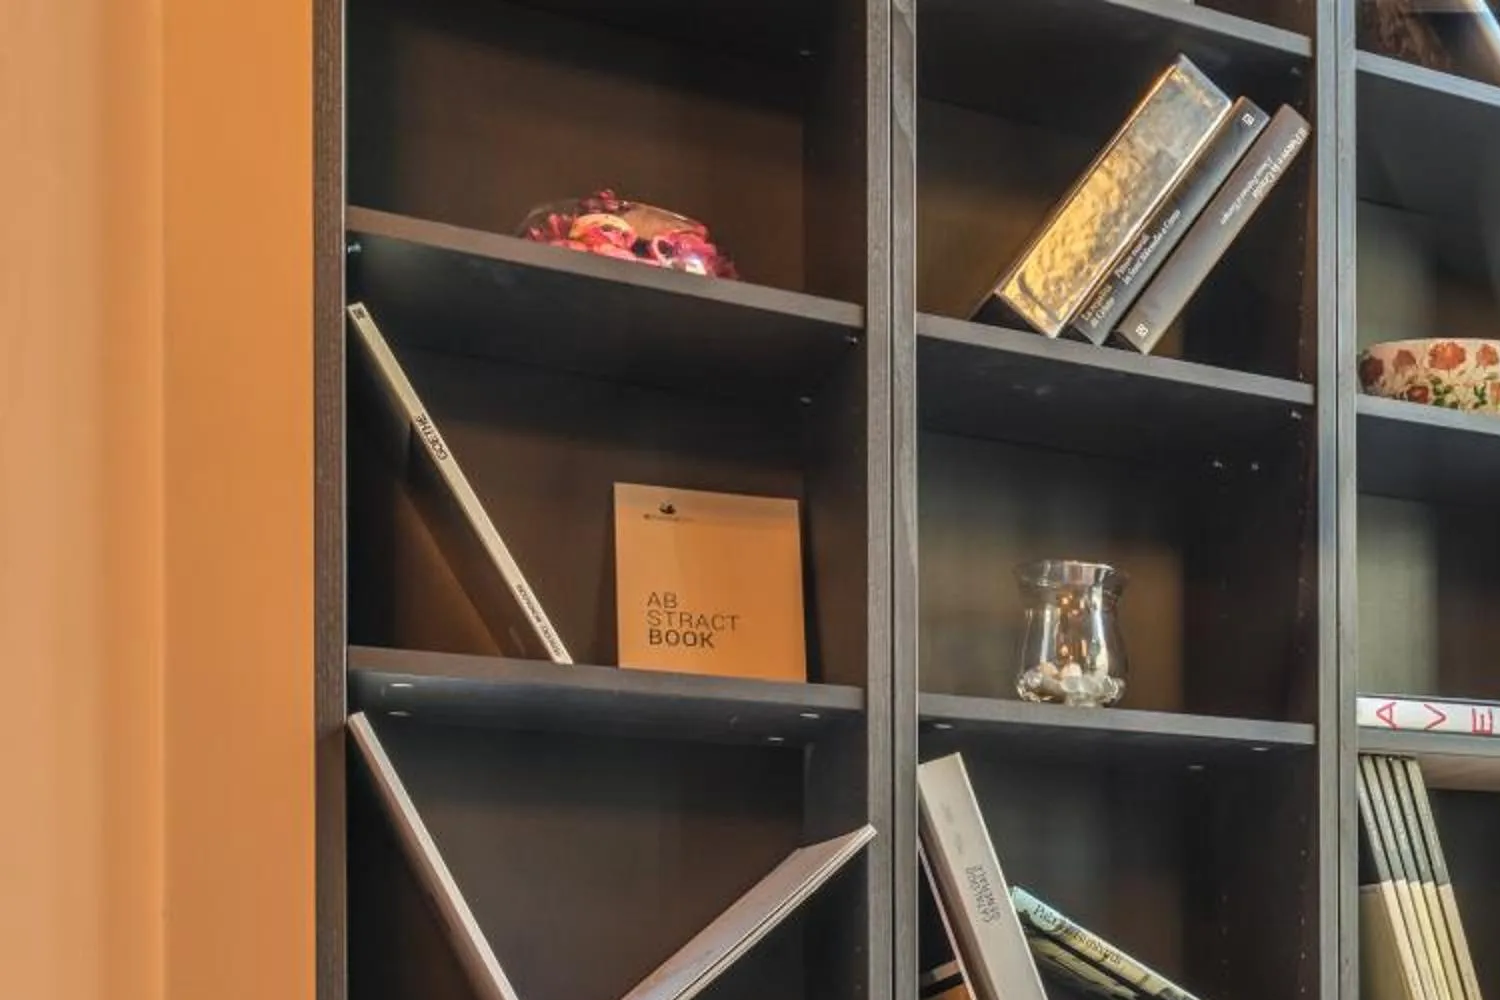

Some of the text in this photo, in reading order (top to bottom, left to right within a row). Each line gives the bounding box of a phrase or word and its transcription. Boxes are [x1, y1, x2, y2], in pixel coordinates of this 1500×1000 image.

[647, 591, 678, 609] AB
[647, 609, 741, 632] STRACT
[649, 628, 715, 649] BOOK
